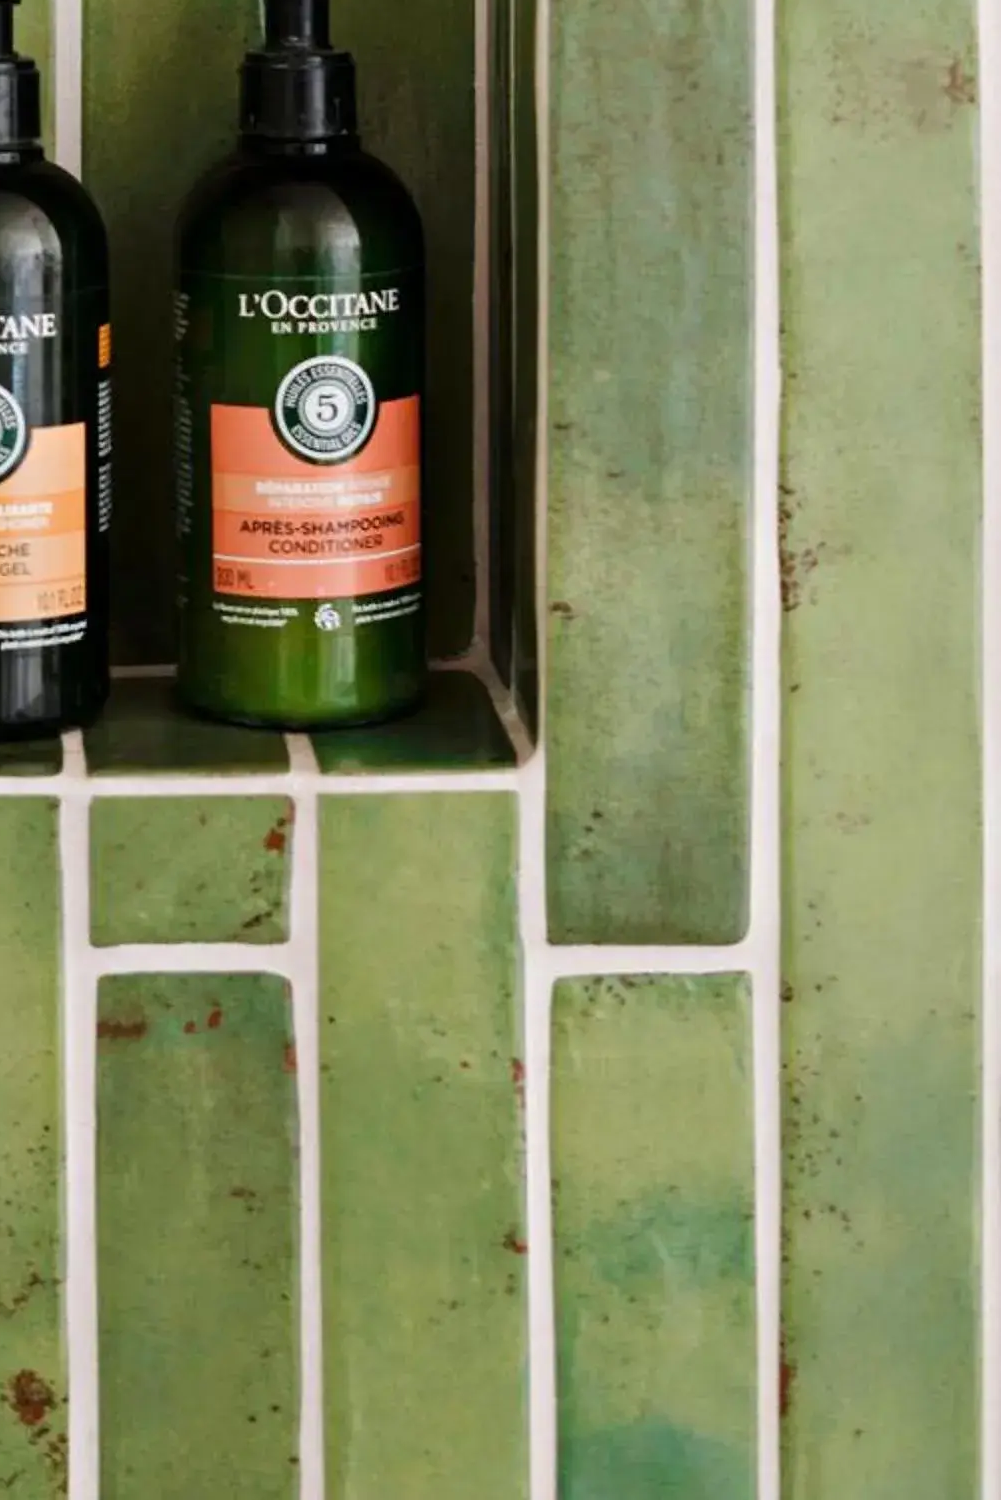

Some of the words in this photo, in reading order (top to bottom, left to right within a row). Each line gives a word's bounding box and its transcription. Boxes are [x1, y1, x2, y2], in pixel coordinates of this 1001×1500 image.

[238, 288, 400, 318] L'OCCITANE
[271, 320, 293, 334] EN
[297, 318, 378, 334] PROVENCE
[316, 394, 338, 422] 5
[239, 511, 405, 536] APRÈS-SHAMPOOING
[268, 535, 383, 554] CONDITIONER
